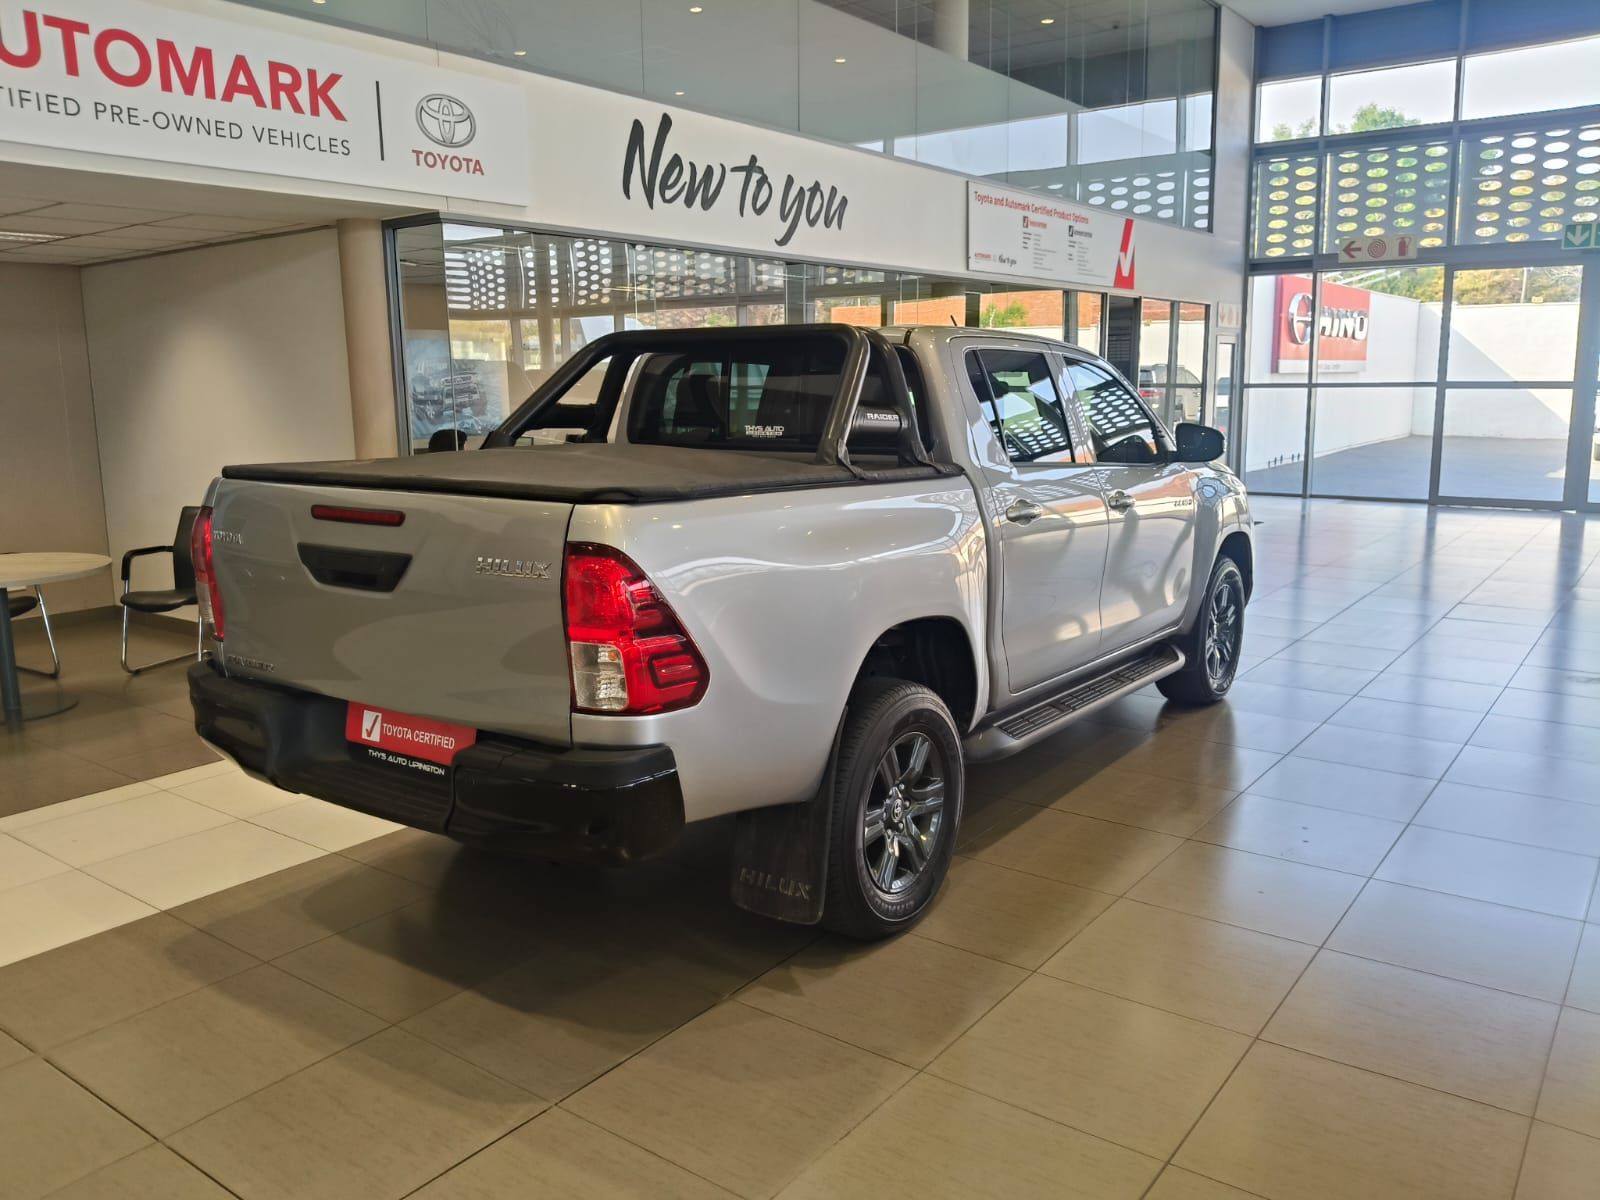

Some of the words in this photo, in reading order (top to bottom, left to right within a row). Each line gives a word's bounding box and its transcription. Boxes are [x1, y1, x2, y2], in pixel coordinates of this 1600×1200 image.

[0, 10, 347, 122] UTOMARK
[0, 86, 81, 116] IFIED
[94, 101, 243, 139] PRE-OWNED
[252, 125, 351, 156] VEHICLES
[412, 149, 484, 176] TOYOTA
[622, 112, 726, 211] New
[730, 154, 773, 218] to
[774, 174, 848, 247] you
[974, 191, 993, 205] Toyota
[994, 197, 1004, 207] and
[1005, 198, 1030, 211] Automark
[1031, 203, 1053, 217] Certified
[866, 412, 899, 421] RAIDER
[476, 557, 552, 579] HILUX
[382, 723, 412, 741] TOYOTA
[413, 730, 455, 750] CERTIFIED
[368, 749, 387, 760] THYS
[387, 755, 407, 766] AUTO
[408, 760, 445, 775] UPINGTON
[740, 867, 811, 900] HILUX
